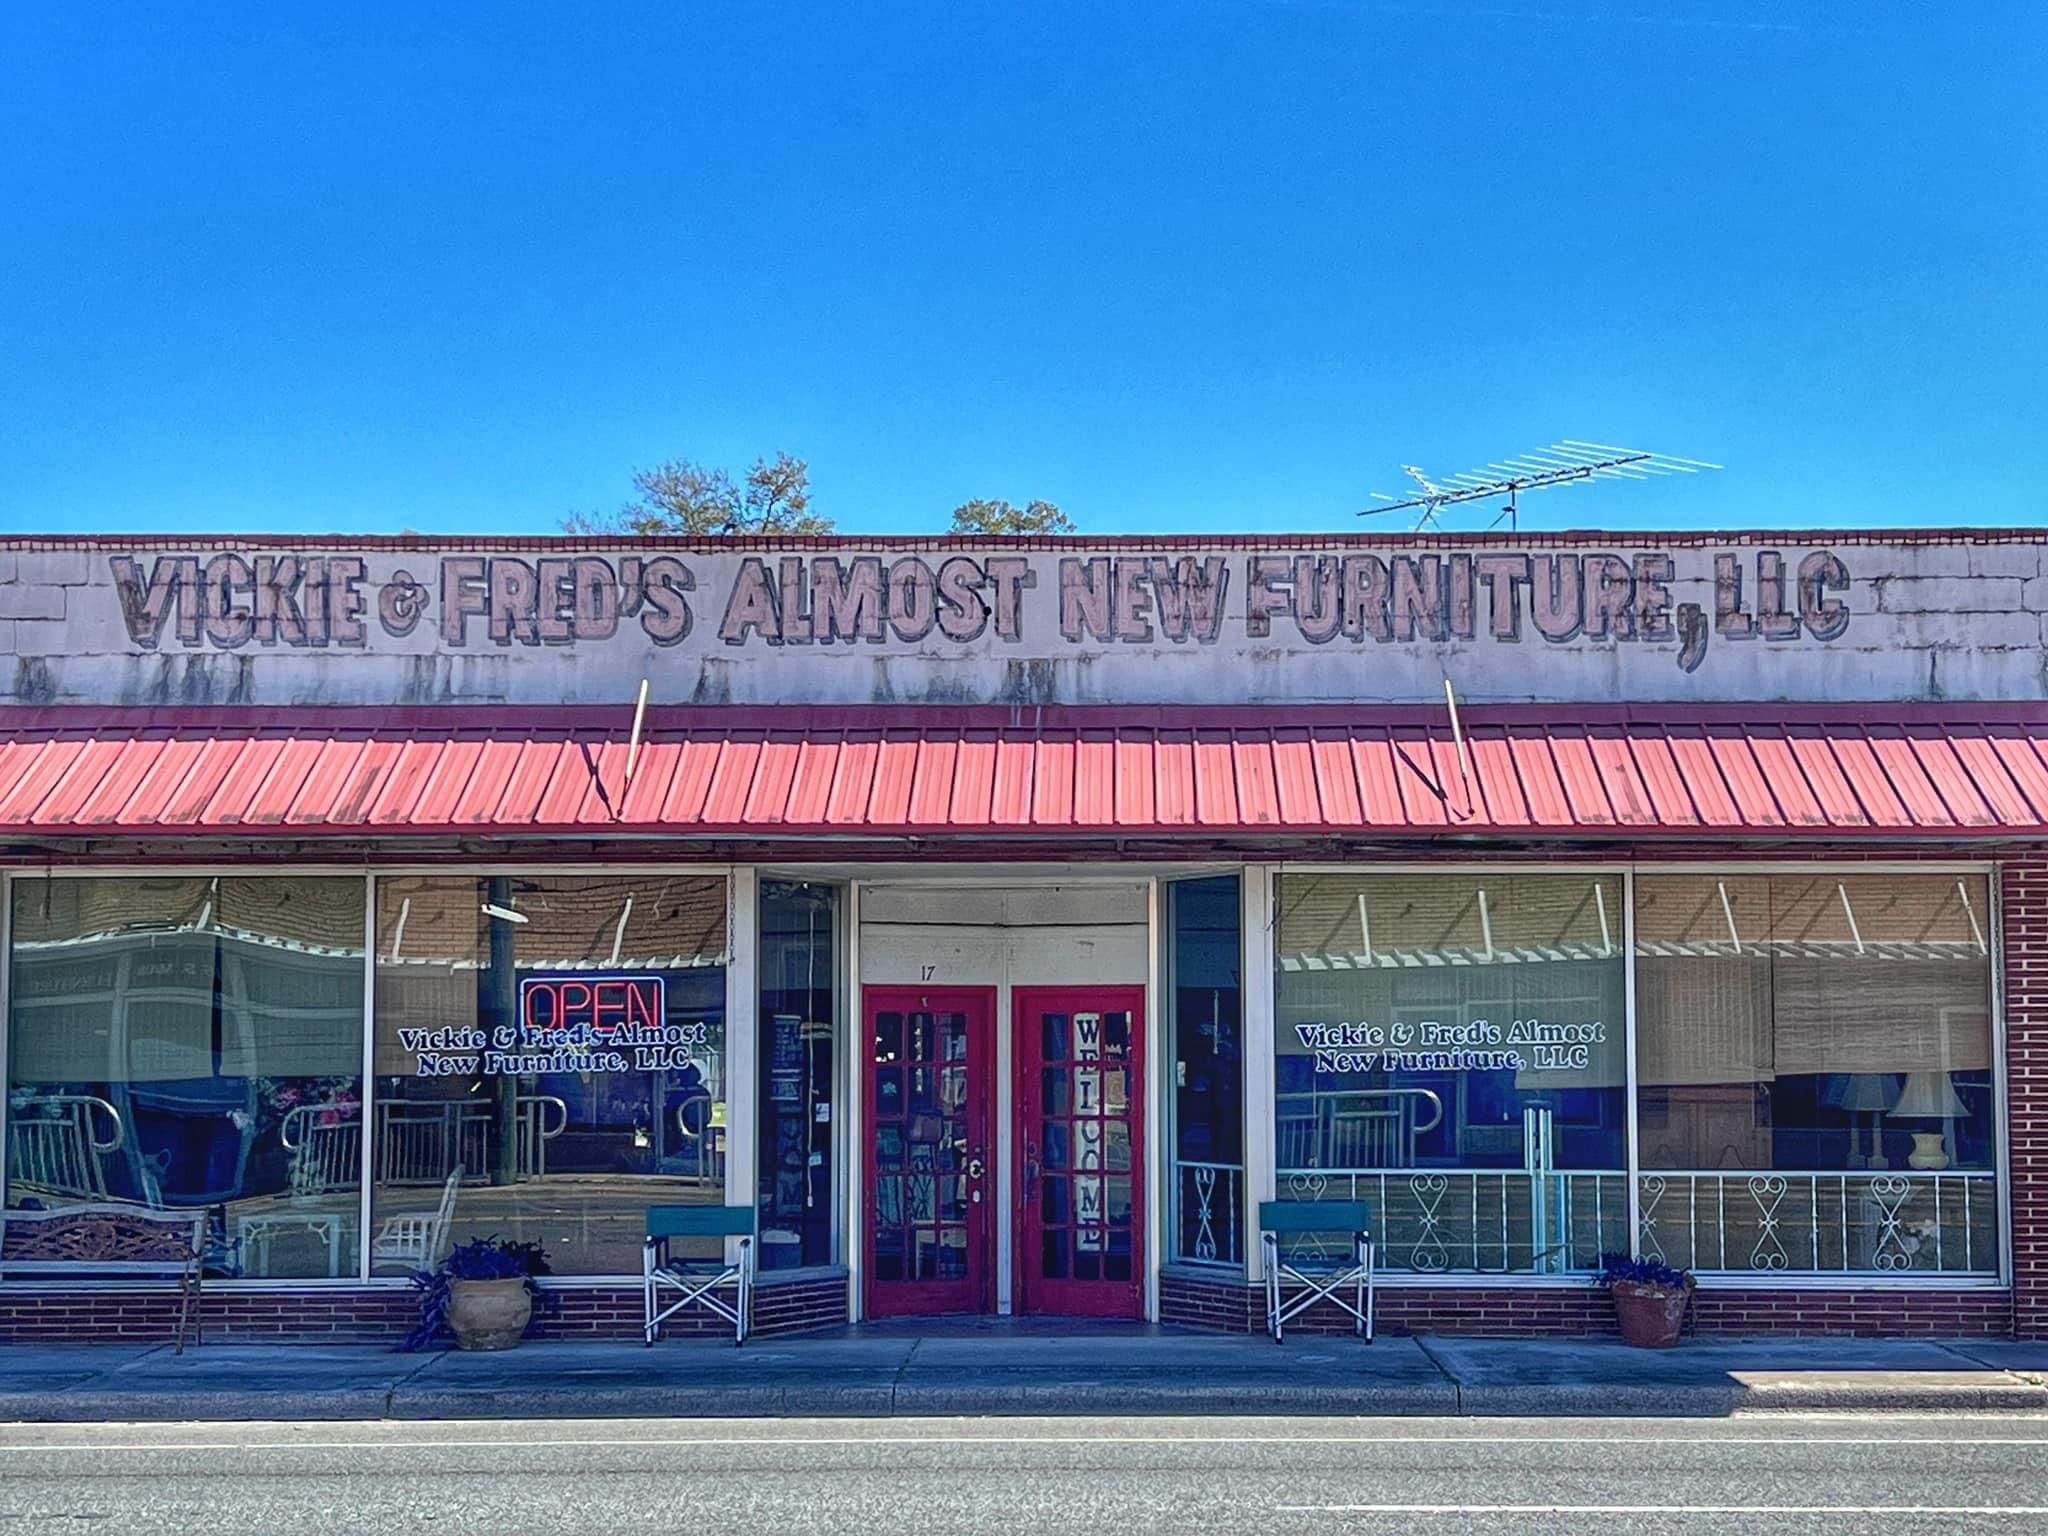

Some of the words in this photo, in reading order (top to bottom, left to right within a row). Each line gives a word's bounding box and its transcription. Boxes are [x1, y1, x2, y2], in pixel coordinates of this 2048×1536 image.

[110, 554, 369, 648] VICKIE
[378, 569, 430, 638] &
[439, 554, 697, 648] FRED'S
[717, 555, 1038, 647] ALMOST
[1058, 555, 1231, 646] NEW
[1246, 551, 1708, 673] FURNITURE,
[1713, 550, 1850, 643] LLC
[920, 965, 936, 981] 17
[525, 981, 659, 1031] OPEN
[398, 1024, 487, 1051] Vickie
[492, 1026, 517, 1048] &
[524, 1022, 604, 1048] Fred's
[609, 1020, 707, 1046] Almost
[1295, 1021, 1384, 1047] Vickie
[1390, 1022, 1415, 1046] &
[1420, 1020, 1501, 1045] Fred's
[1506, 1019, 1606, 1044] Almost
[417, 1052, 479, 1077] New
[484, 1048, 630, 1076] Furniture,
[635, 1046, 690, 1071] LLC
[1315, 1050, 1378, 1072] New
[1383, 1046, 1526, 1072] Furniture,
[1533, 1045, 1589, 1068] LLC
